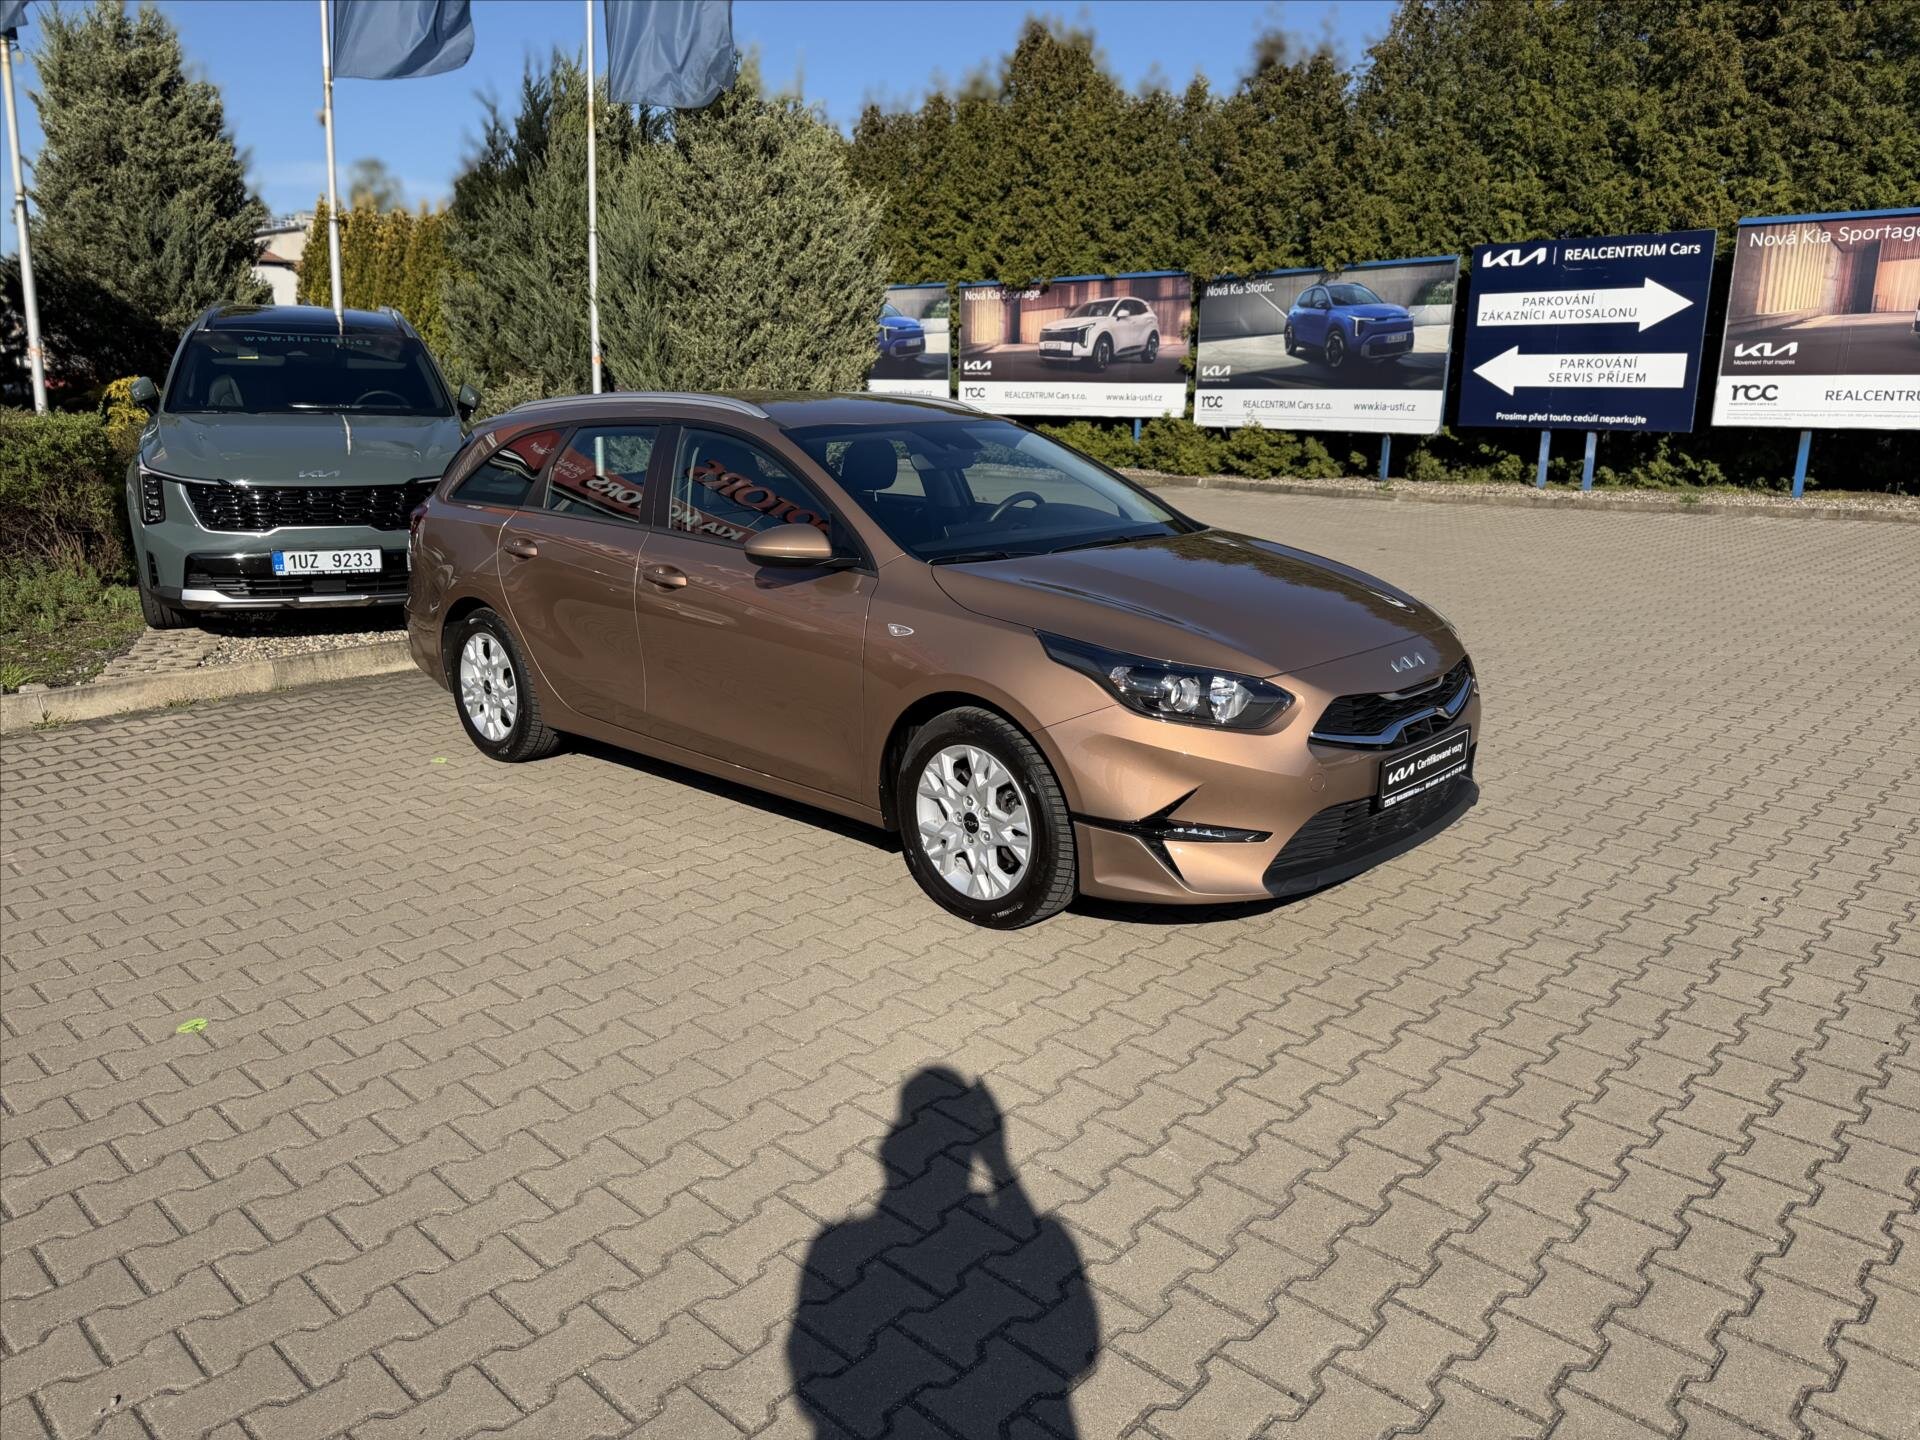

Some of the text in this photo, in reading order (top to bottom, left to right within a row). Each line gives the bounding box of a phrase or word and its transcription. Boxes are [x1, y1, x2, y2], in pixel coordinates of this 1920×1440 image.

[1750, 231, 1797, 247] Nová
[1803, 229, 1832, 245] Kia
[1482, 242, 1701, 268] KIA REALCENTRUM Cars
[965, 290, 986, 301] Nová
[987, 289, 1001, 300] Kia
[1206, 284, 1228, 297] Nová
[1230, 283, 1244, 295] Kia
[1522, 292, 1596, 307] PARKOVÁNÍ
[1481, 307, 1638, 322] ZÁKAZNÍCI AUTOSALONU
[1734, 342, 1799, 357] KIA
[963, 360, 992, 370] KIA
[1559, 355, 1638, 369] PARKOVÁNÍ
[1201, 365, 1231, 376] KIA
[1548, 370, 1647, 383] SERVIS PŘÍJEM
[965, 387, 986, 398] rcc
[1004, 391, 1055, 400] REALCENTRUM
[1055, 392, 1070, 400] Cars
[1731, 384, 1779, 401] rcc
[1201, 396, 1223, 408] rcc
[1243, 400, 1333, 410] REALCENTRUM Cars s.r.o.
[1353, 402, 1416, 412] www.kia-usti.cz
[1496, 412, 1647, 426] Prosíme před touto cedulí neparkujte
[289, 554, 320, 569] 1UZ
[332, 552, 373, 568] 9233
[1387, 763, 1415, 785] KIA
